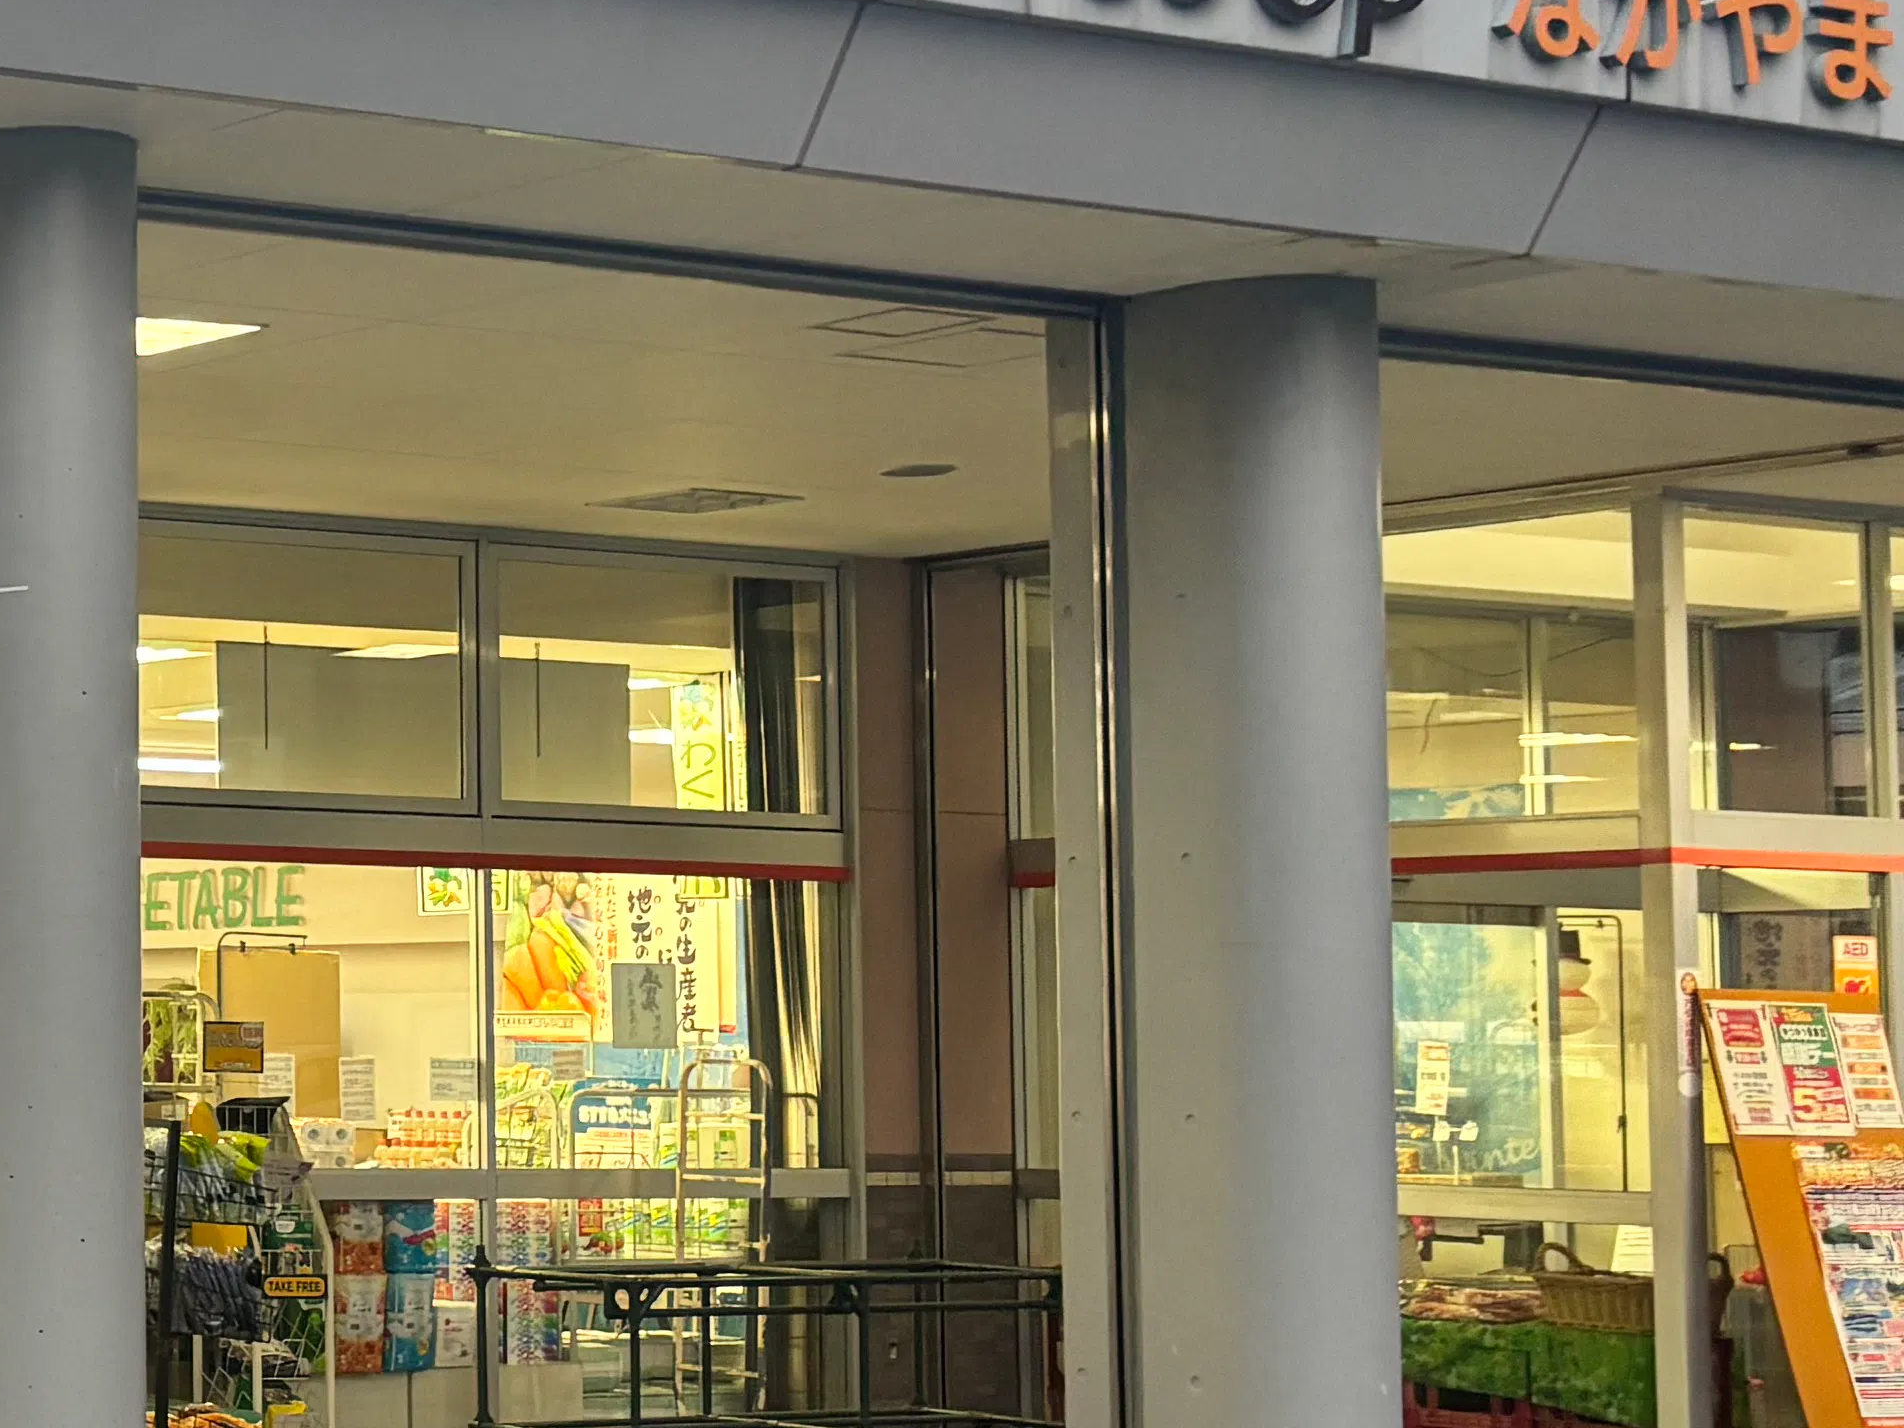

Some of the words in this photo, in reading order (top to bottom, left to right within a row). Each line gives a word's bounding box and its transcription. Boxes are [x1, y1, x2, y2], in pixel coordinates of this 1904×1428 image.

[628, 886, 653, 959] 地元の
[1842, 942, 1869, 957] AED
[268, 1281, 293, 1293] TAKE
[296, 1281, 321, 1293] FREE
